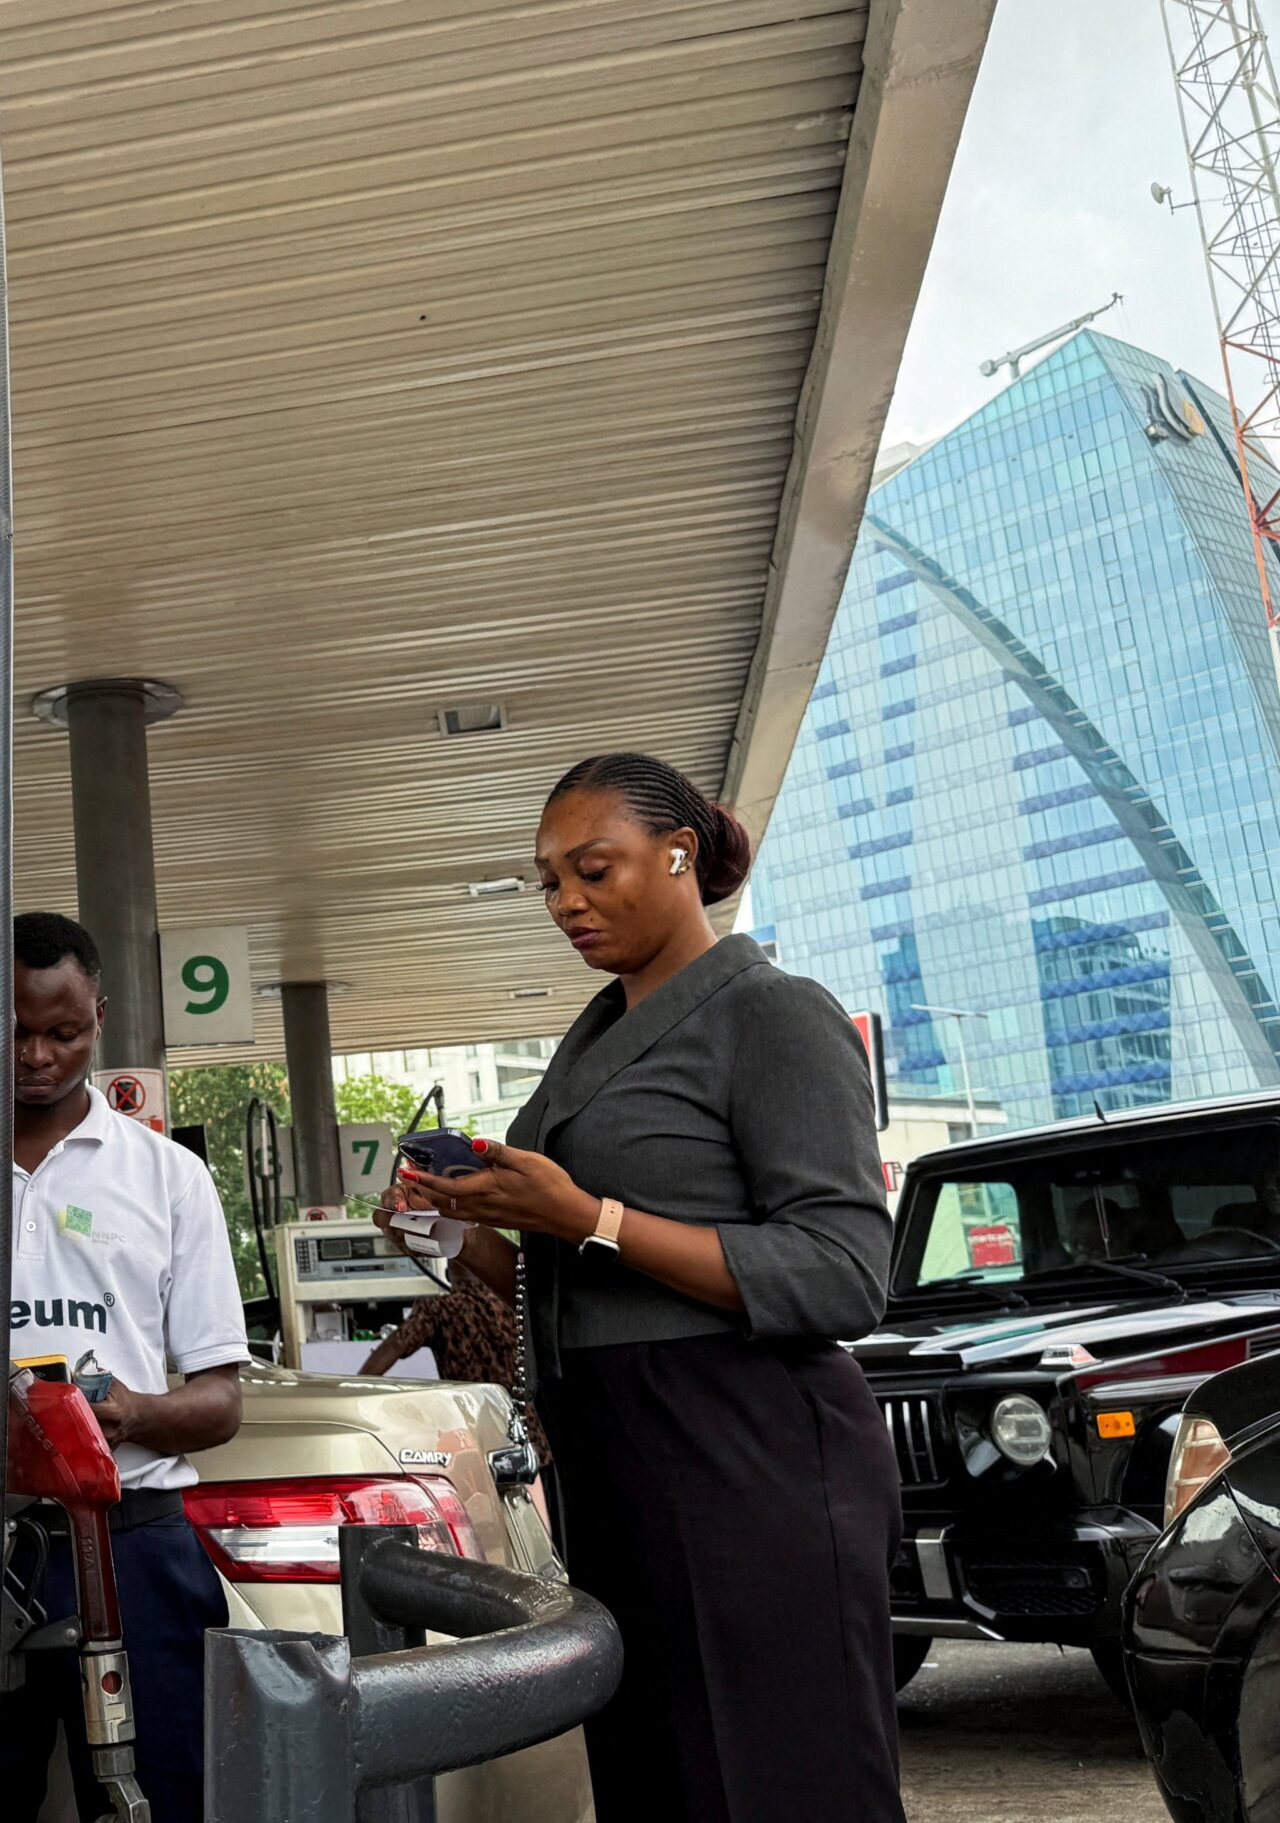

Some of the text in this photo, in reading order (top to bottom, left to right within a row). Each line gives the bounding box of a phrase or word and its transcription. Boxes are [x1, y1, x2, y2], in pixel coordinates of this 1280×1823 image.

[181, 955, 230, 1015] 9
[351, 1139, 380, 1176] 7
[399, 1448, 452, 1467] CAMRY
